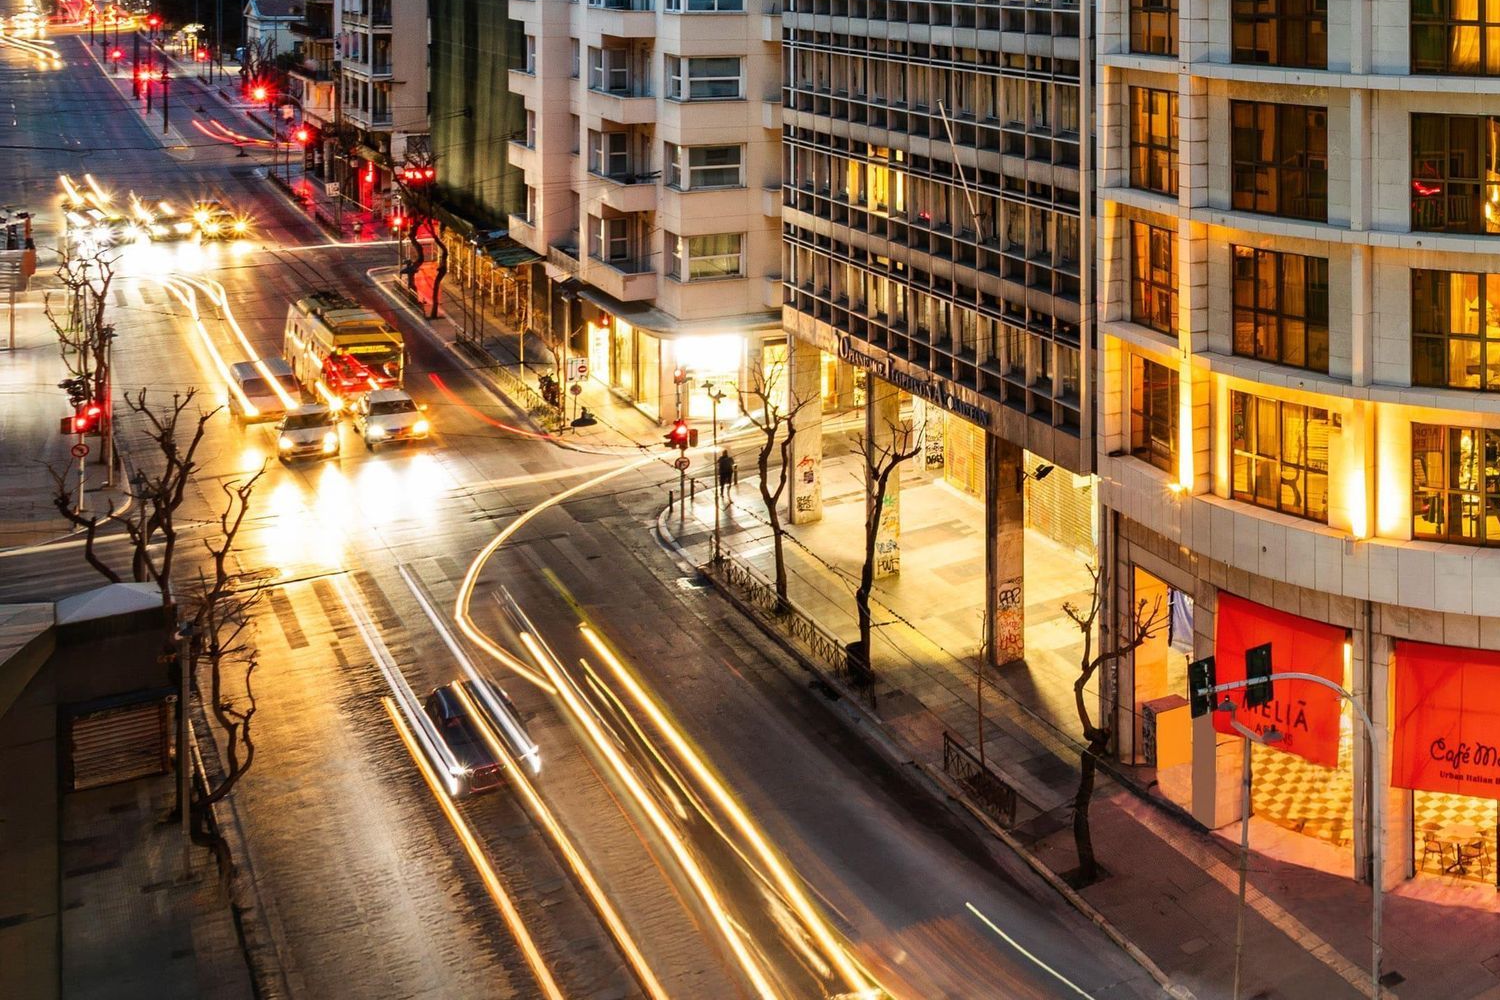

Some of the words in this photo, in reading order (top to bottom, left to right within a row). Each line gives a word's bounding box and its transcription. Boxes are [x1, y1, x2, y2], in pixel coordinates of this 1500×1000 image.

[1430, 737, 1471, 769] Café
[1439, 770, 1464, 781] Urban
[1466, 774, 1493, 785] Italian
